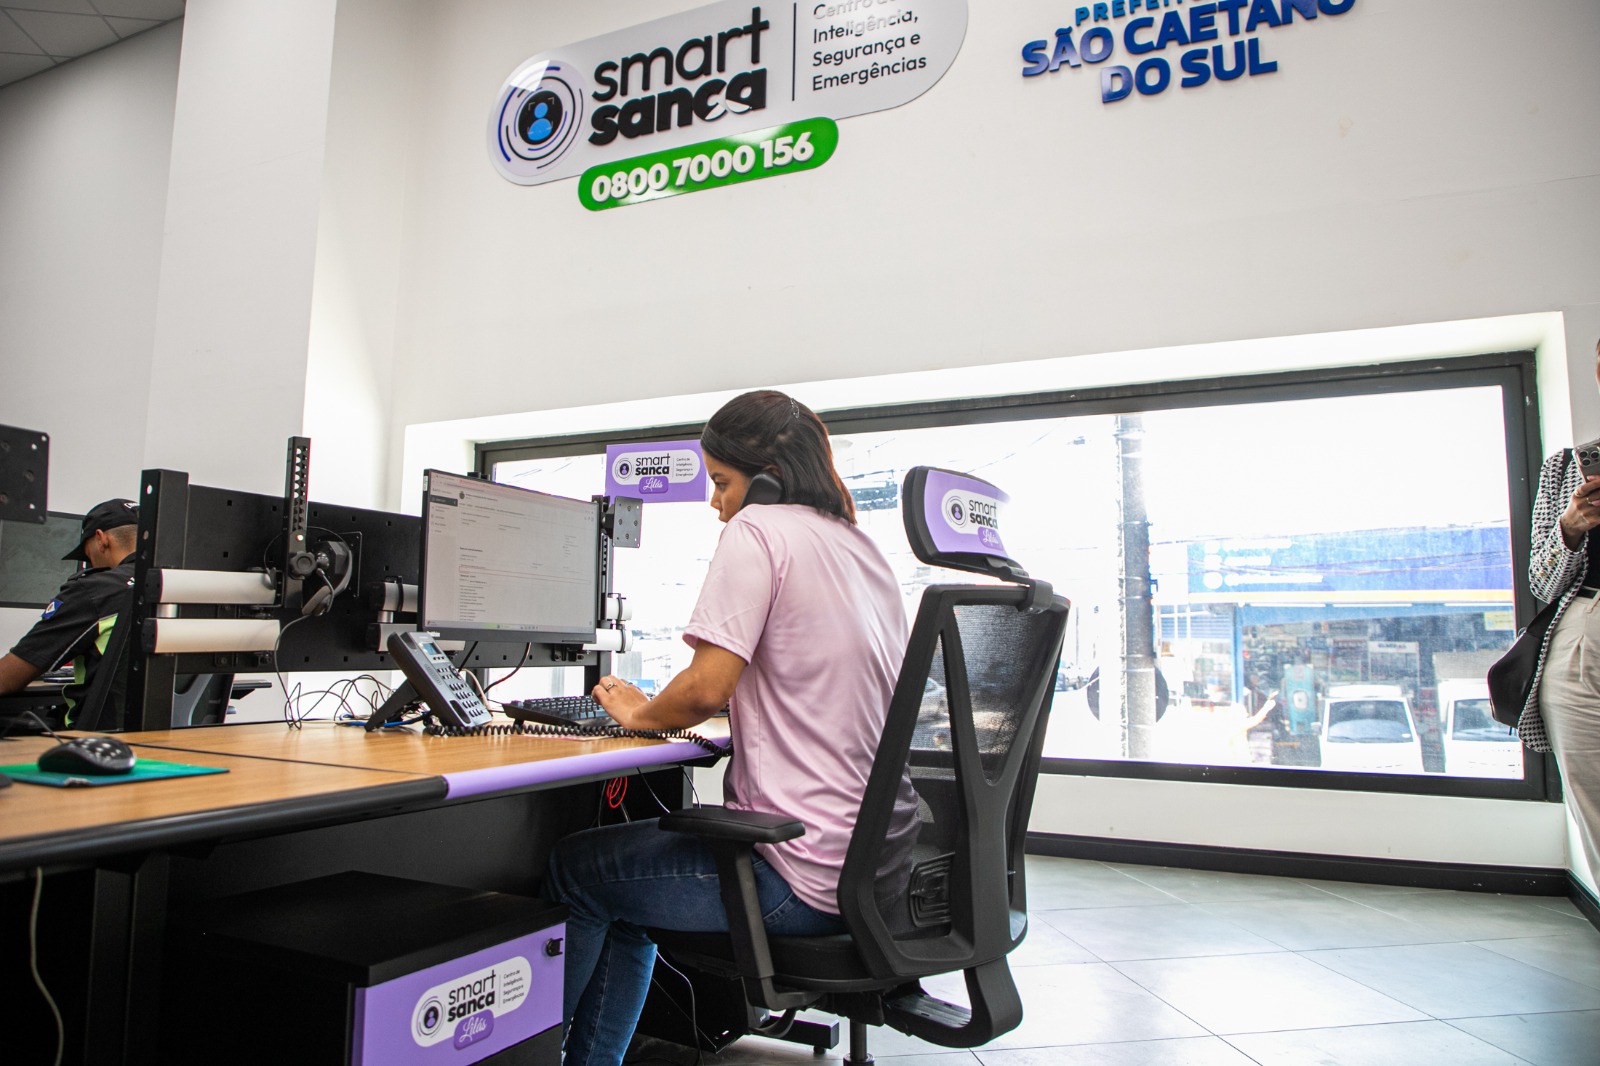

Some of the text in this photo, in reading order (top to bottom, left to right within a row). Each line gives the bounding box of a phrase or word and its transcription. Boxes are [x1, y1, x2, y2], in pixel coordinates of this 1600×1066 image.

[591, 6, 770, 101] smart
[812, 33, 921, 67] Segurança e
[1022, 26, 1114, 77] SÃO
[812, 56, 927, 91] Emergências
[1101, 38, 1278, 103] DO SUL
[588, 68, 768, 147] sanca
[591, 131, 815, 203] 0800 7000 156
[635, 453, 671, 467] smart
[635, 466, 670, 476] sanca
[969, 499, 997, 517] smart
[969, 512, 998, 530] sanca
[448, 969, 497, 1006] smart
[447, 990, 495, 1022] sanca
